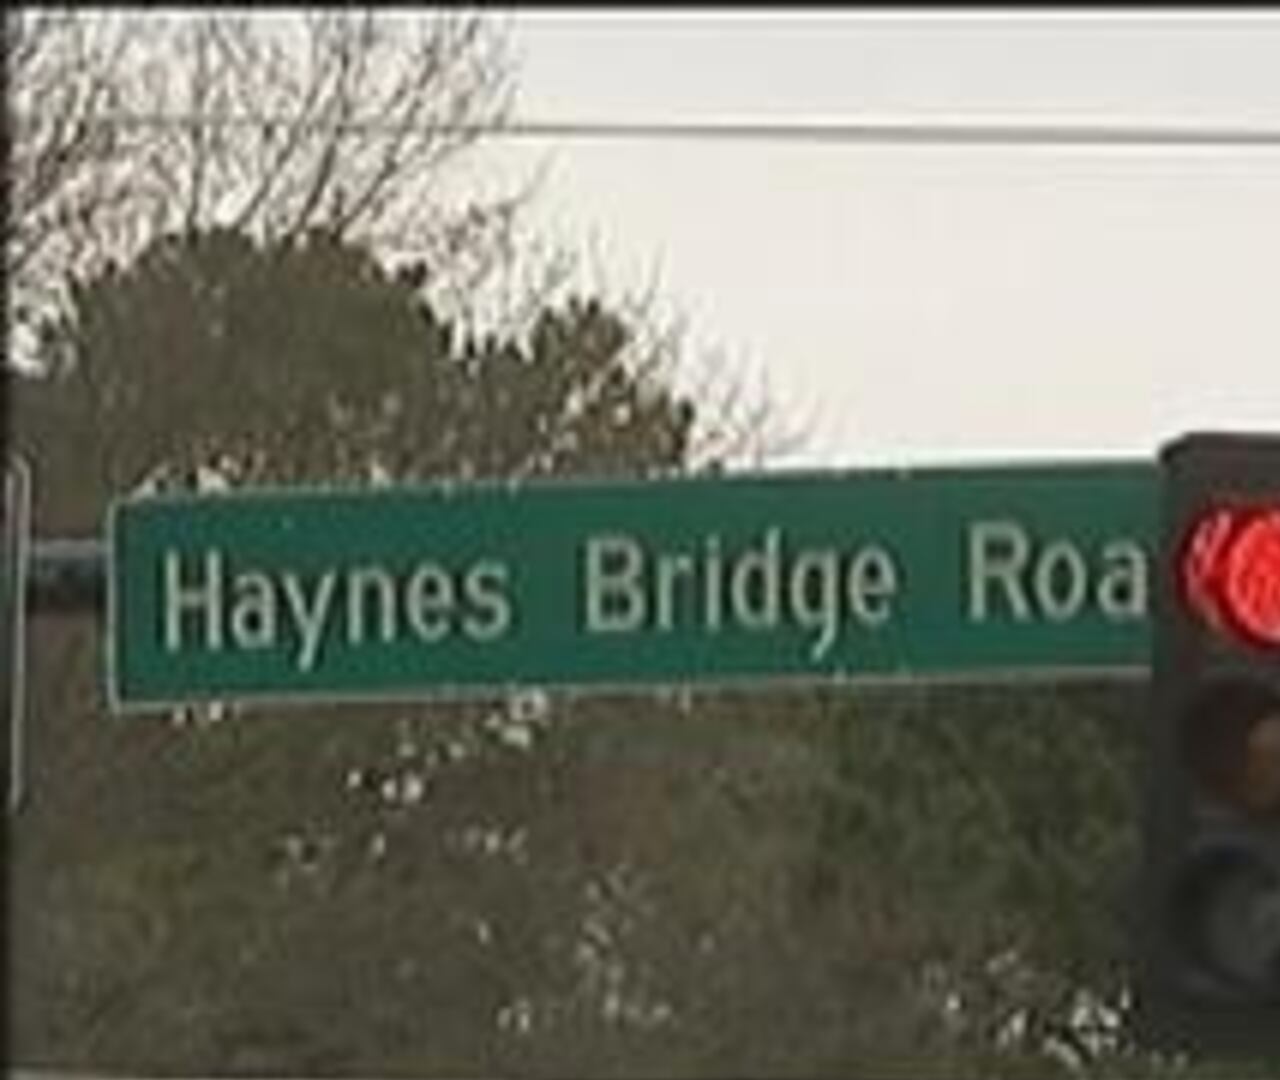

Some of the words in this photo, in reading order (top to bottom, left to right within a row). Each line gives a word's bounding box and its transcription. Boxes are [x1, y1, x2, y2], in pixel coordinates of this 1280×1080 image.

[162, 546, 512, 672] Haynes
[581, 530, 899, 660] Bridge
[966, 518, 1149, 621] Roa
